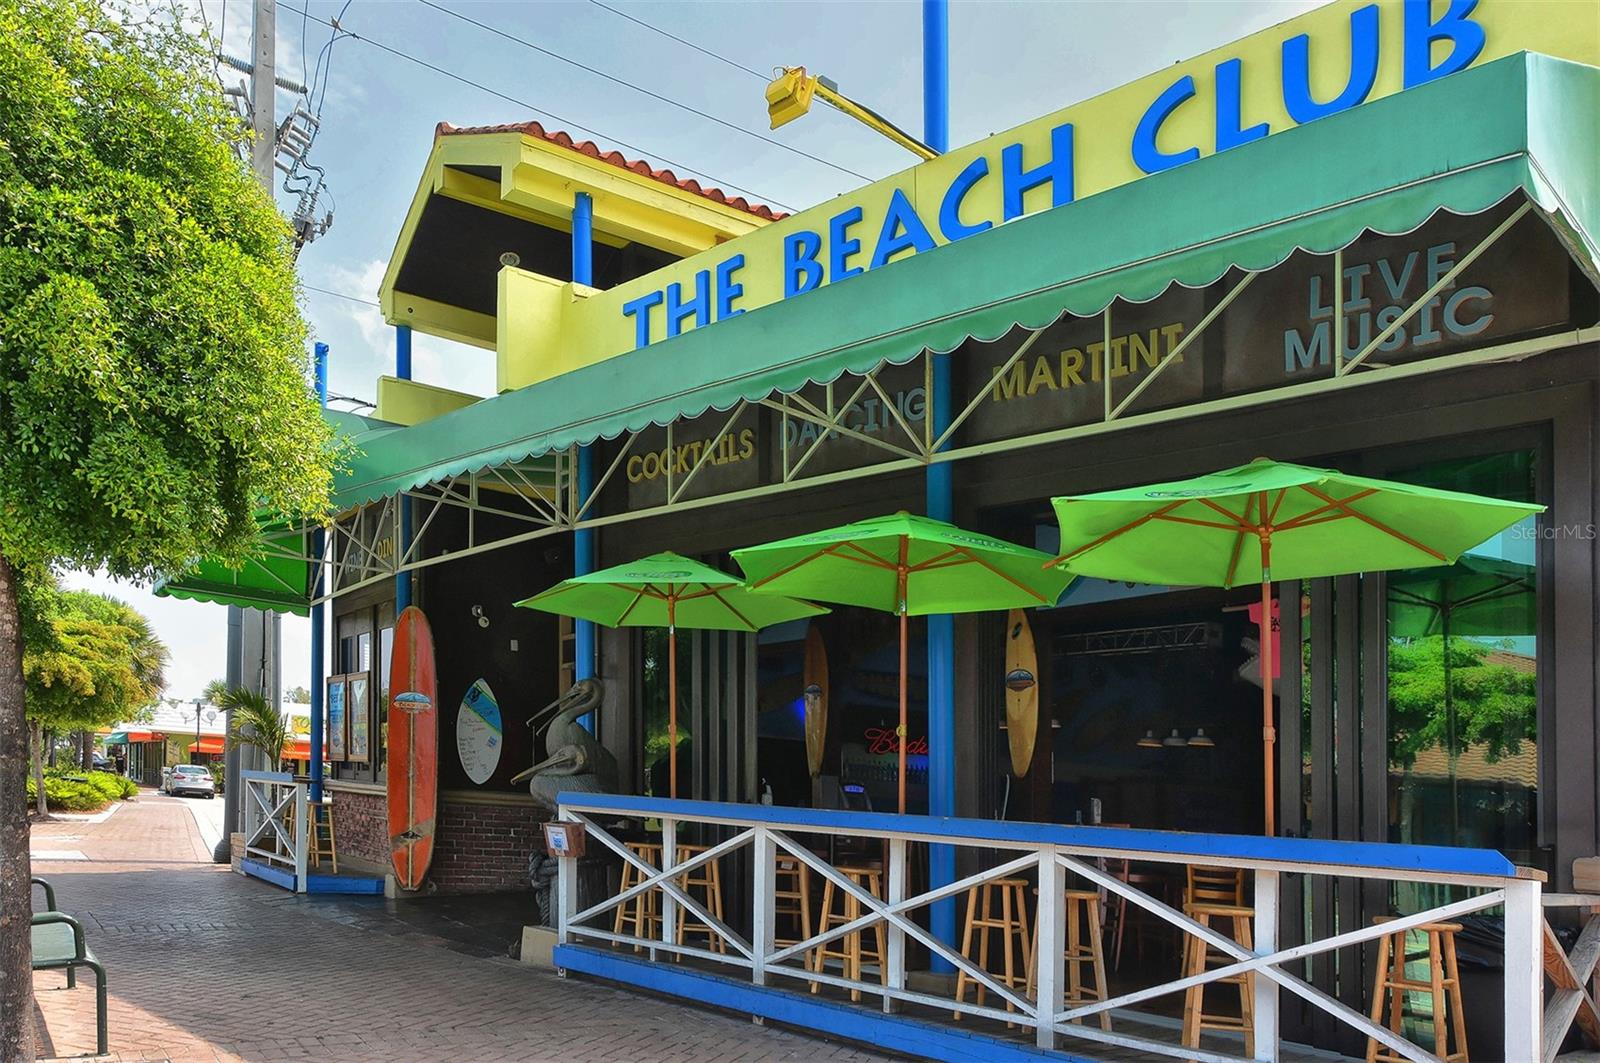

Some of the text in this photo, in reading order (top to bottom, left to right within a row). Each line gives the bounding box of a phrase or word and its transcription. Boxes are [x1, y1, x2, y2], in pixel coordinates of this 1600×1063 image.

[622, 0, 1487, 349] THE BEACH CLUB
[1309, 241, 1456, 320] LIVE
[992, 322, 1184, 402] MARTINI
[1284, 286, 1495, 373] MUSIC
[626, 428, 754, 484] COCKTAILS
